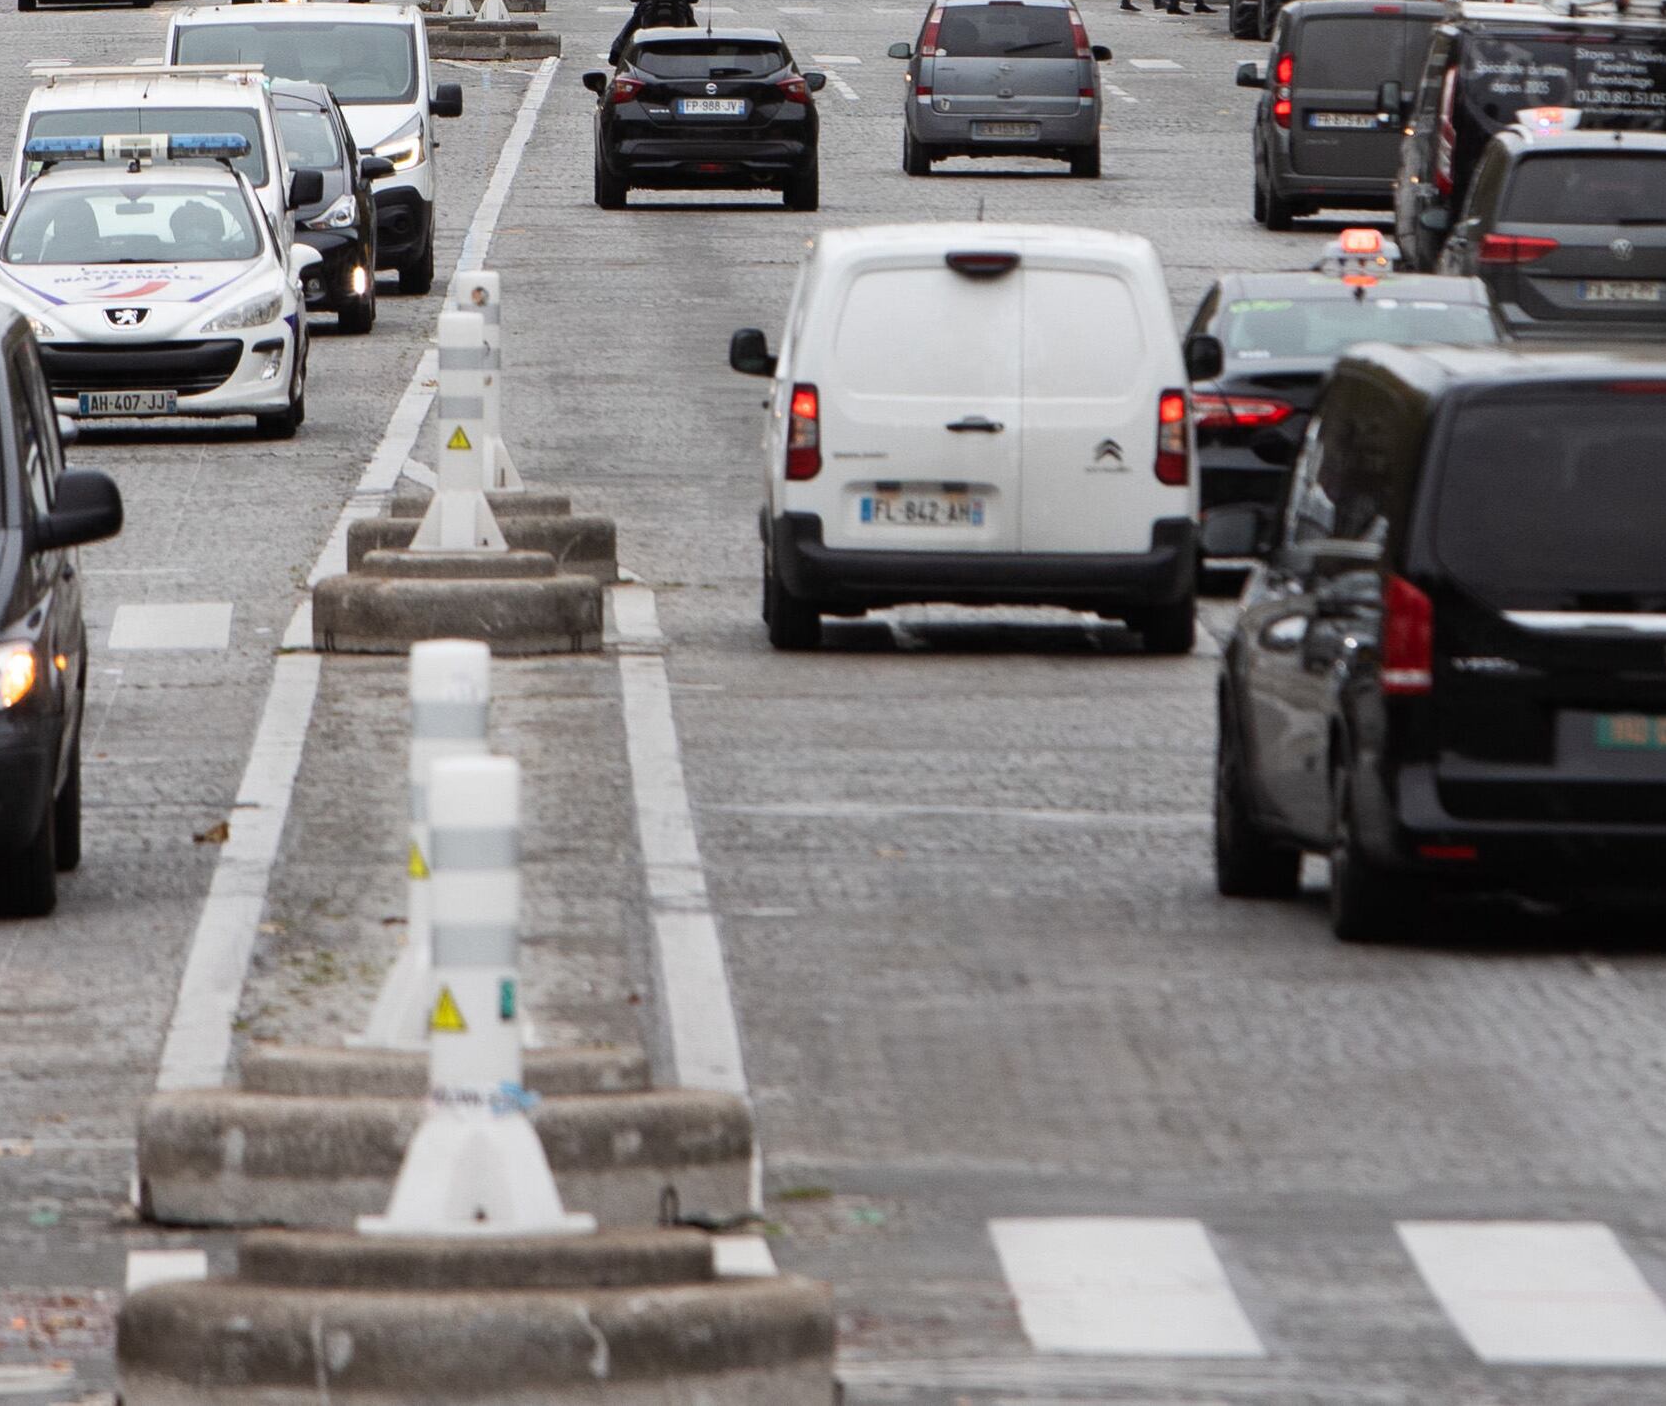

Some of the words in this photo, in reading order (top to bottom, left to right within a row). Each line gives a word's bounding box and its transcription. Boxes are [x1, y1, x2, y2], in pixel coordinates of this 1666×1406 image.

[685, 100, 737, 112] FP-988-JV
[54, 274, 204, 284] NATIONALE
[90, 394, 165, 411] AH-407-JJ
